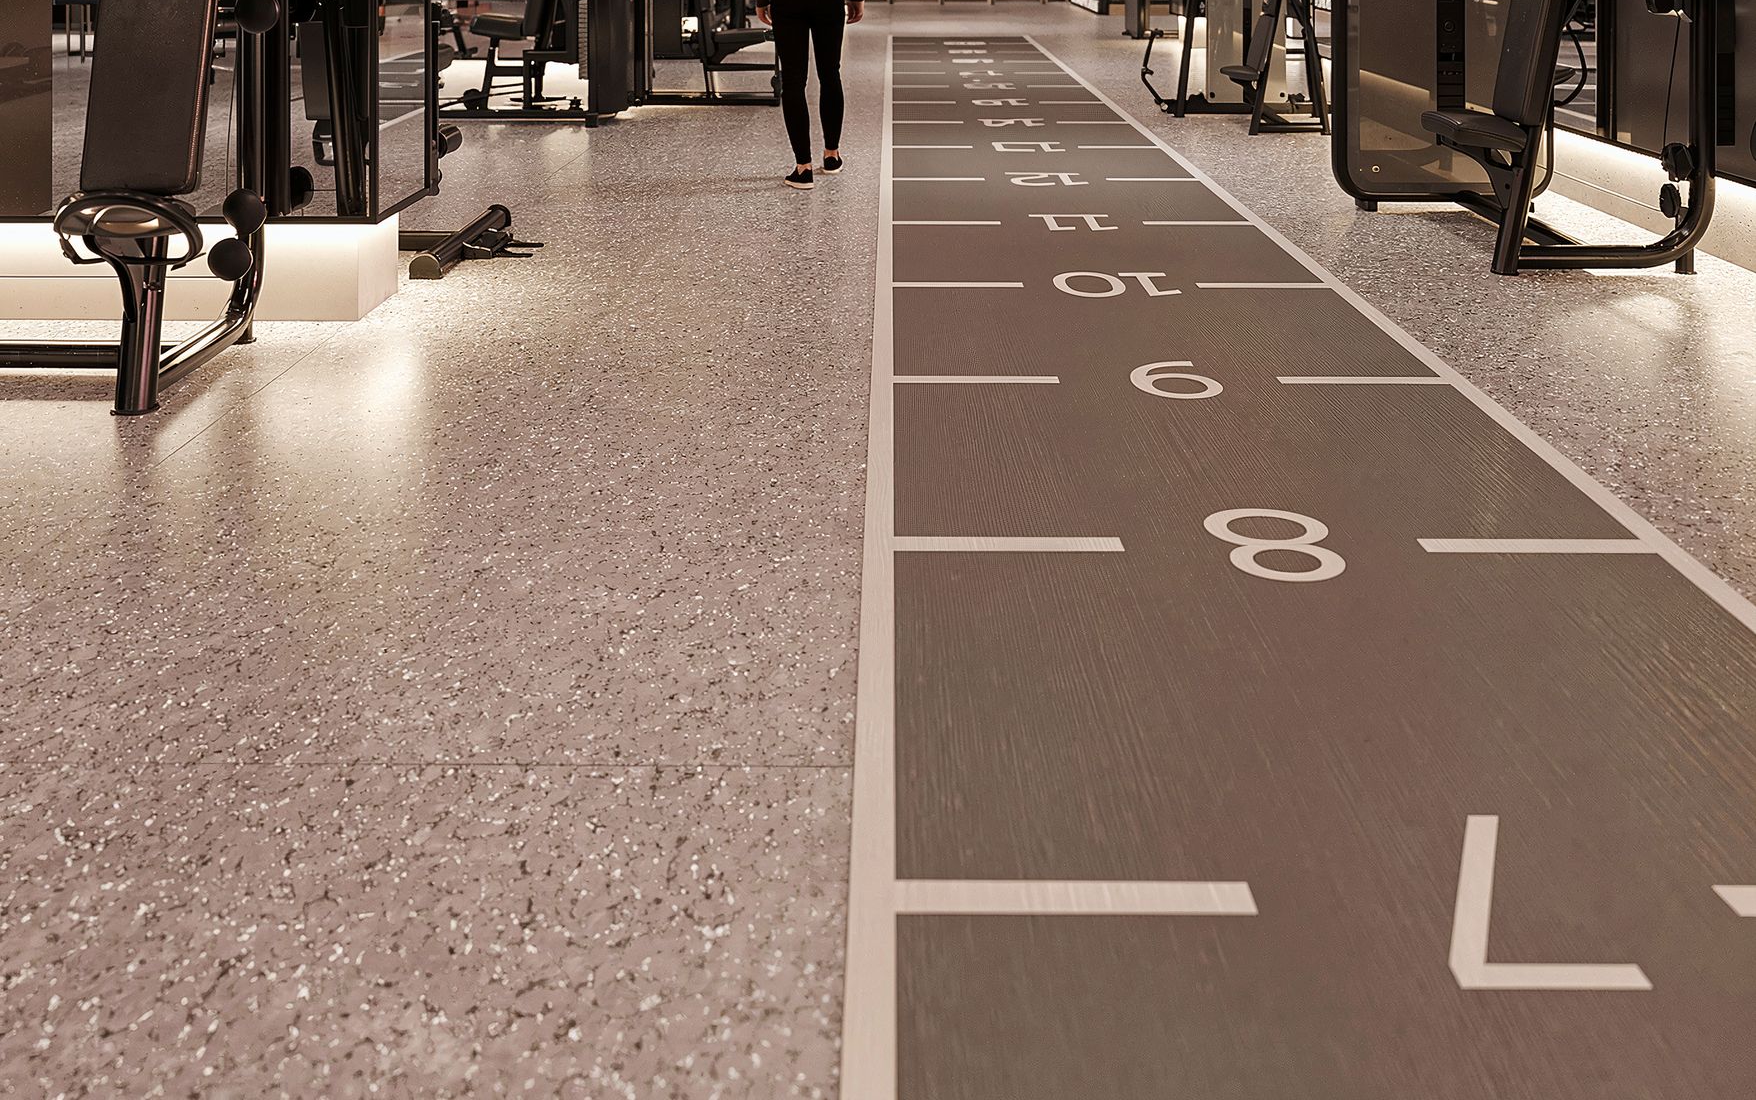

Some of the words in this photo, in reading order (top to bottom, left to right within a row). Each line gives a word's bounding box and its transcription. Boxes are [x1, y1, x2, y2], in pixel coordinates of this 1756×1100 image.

[1004, 171, 1090, 188] 12
[1028, 213, 1119, 232] 11
[1052, 271, 1183, 298] 10
[1203, 508, 1347, 583] 8
